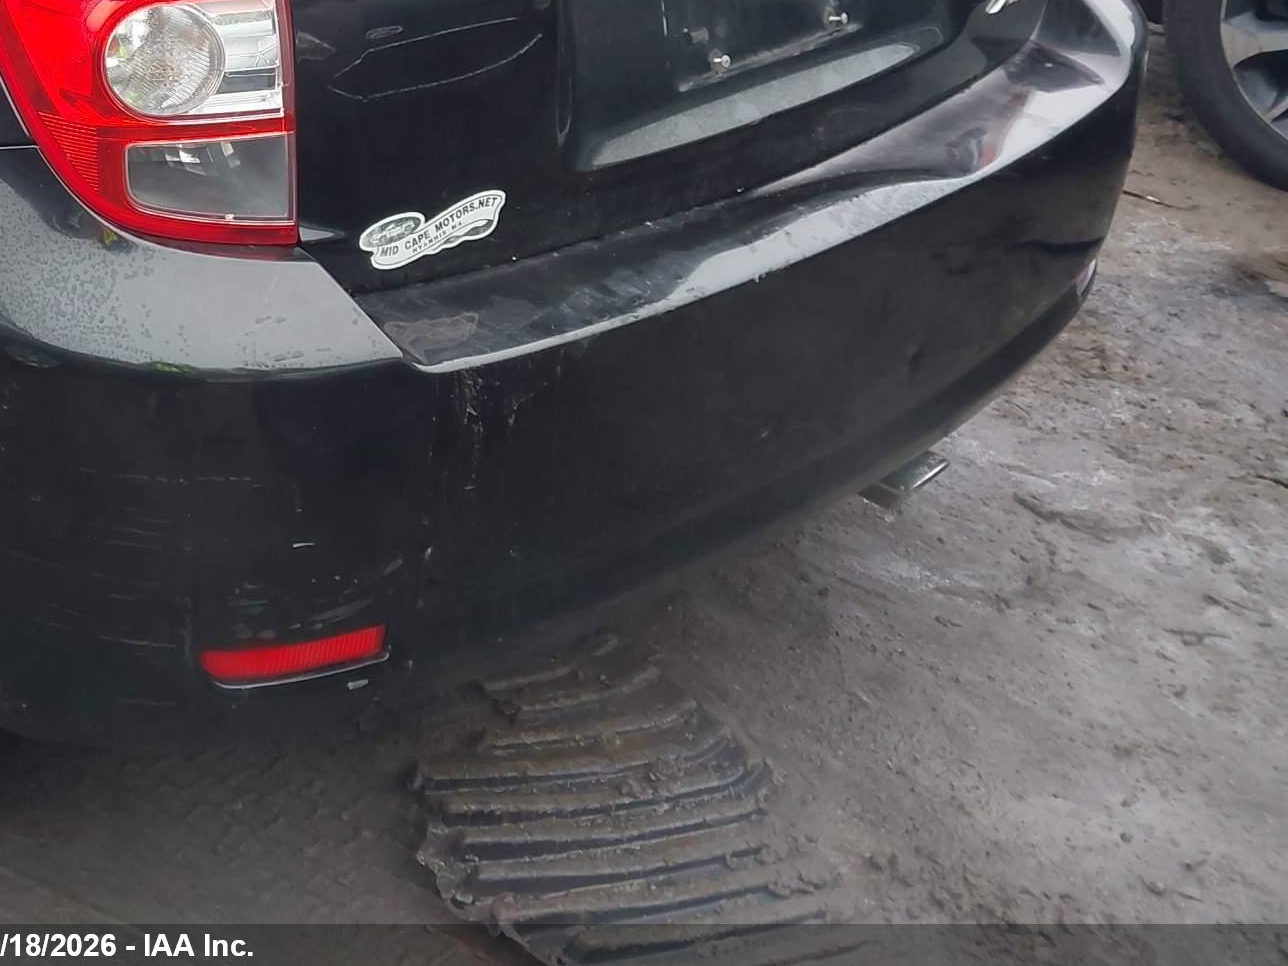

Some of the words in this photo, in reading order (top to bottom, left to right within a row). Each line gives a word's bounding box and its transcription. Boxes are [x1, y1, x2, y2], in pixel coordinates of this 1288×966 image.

[379, 245, 399, 258] MID
[404, 229, 430, 251] CAPE
[434, 196, 498, 232] MOTORS.NET
